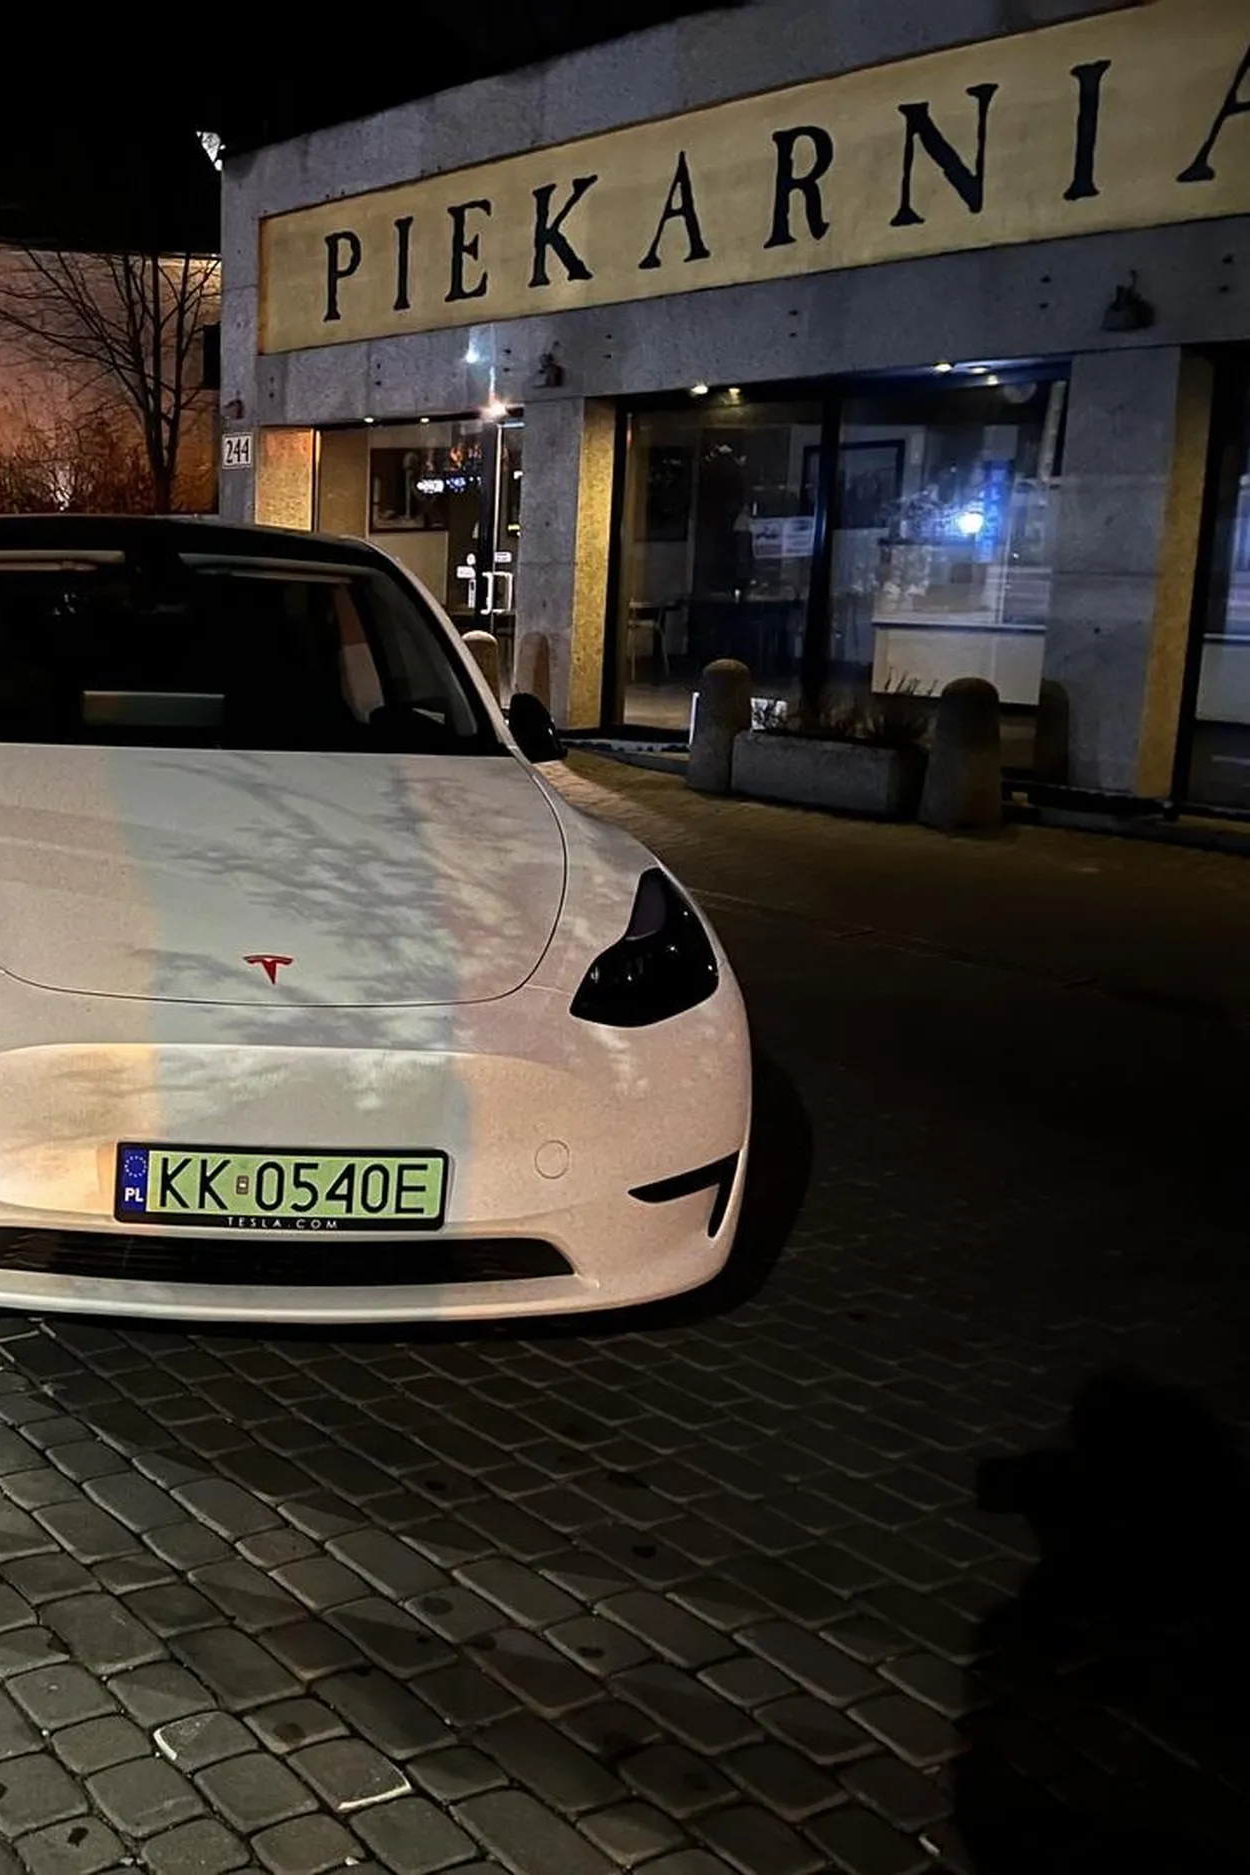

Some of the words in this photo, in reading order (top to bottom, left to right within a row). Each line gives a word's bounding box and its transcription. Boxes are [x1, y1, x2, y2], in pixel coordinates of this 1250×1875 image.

[226, 438, 249, 463] 244
[125, 1187, 144, 1202] PL
[159, 1156, 231, 1210] KK
[254, 1161, 429, 1215] 0540E
